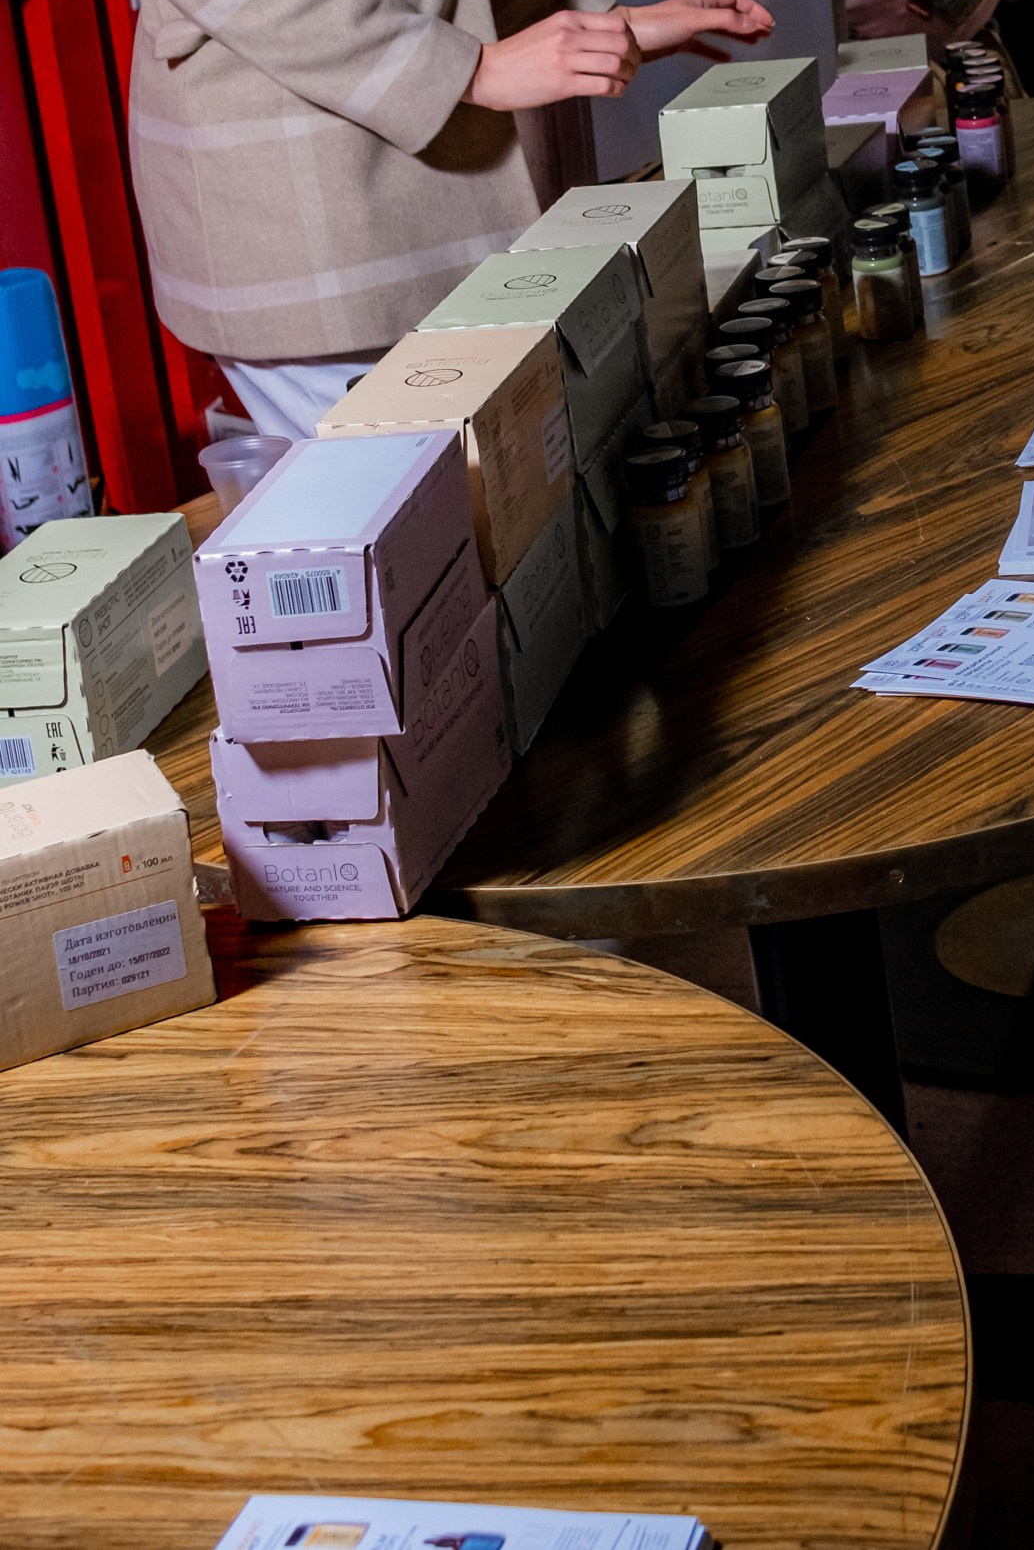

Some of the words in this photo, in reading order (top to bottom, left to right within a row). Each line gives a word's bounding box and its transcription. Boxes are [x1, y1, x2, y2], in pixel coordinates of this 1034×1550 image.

[699, 188, 748, 202] otanIQ
[142, 856, 159, 869] 100
[264, 862, 360, 882] BotanIQ
[24, 871, 64, 887] АКТИВНАЯ
[65, 861, 100, 877] ДОБАВКА
[267, 885, 301, 893] NATURE
[324, 884, 362, 892] SCIENCE,
[293, 893, 338, 902] TOGETHER
[65, 938, 92, 952] Дата
[96, 913, 177, 941] изготовления
[70, 966, 104, 982] Годен
[107, 960, 126, 973] до:
[128, 946, 171, 965] 15/07/2022
[72, 977, 119, 998] Партия:
[121, 970, 150, 985] 029121
